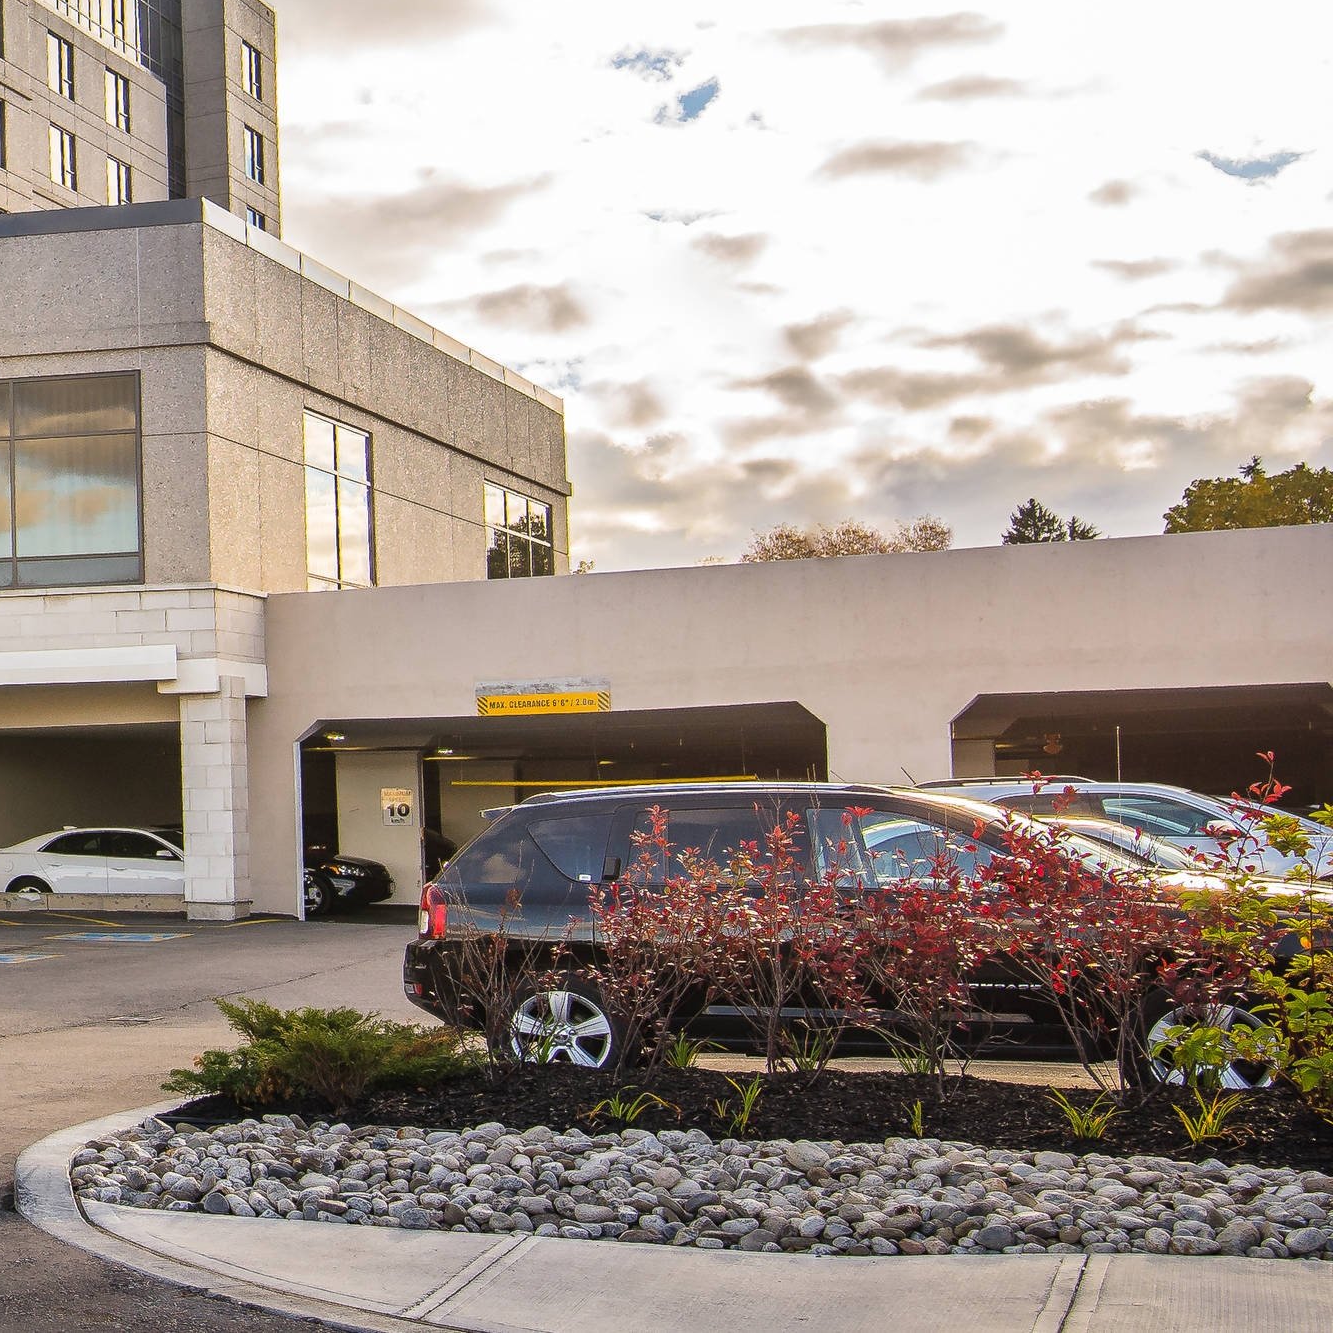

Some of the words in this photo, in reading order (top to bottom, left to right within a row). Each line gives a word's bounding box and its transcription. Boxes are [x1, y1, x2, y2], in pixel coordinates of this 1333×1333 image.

[489, 701, 507, 709] MAX.
[509, 700, 550, 708] CLEARANCE
[386, 803, 410, 817] 10
